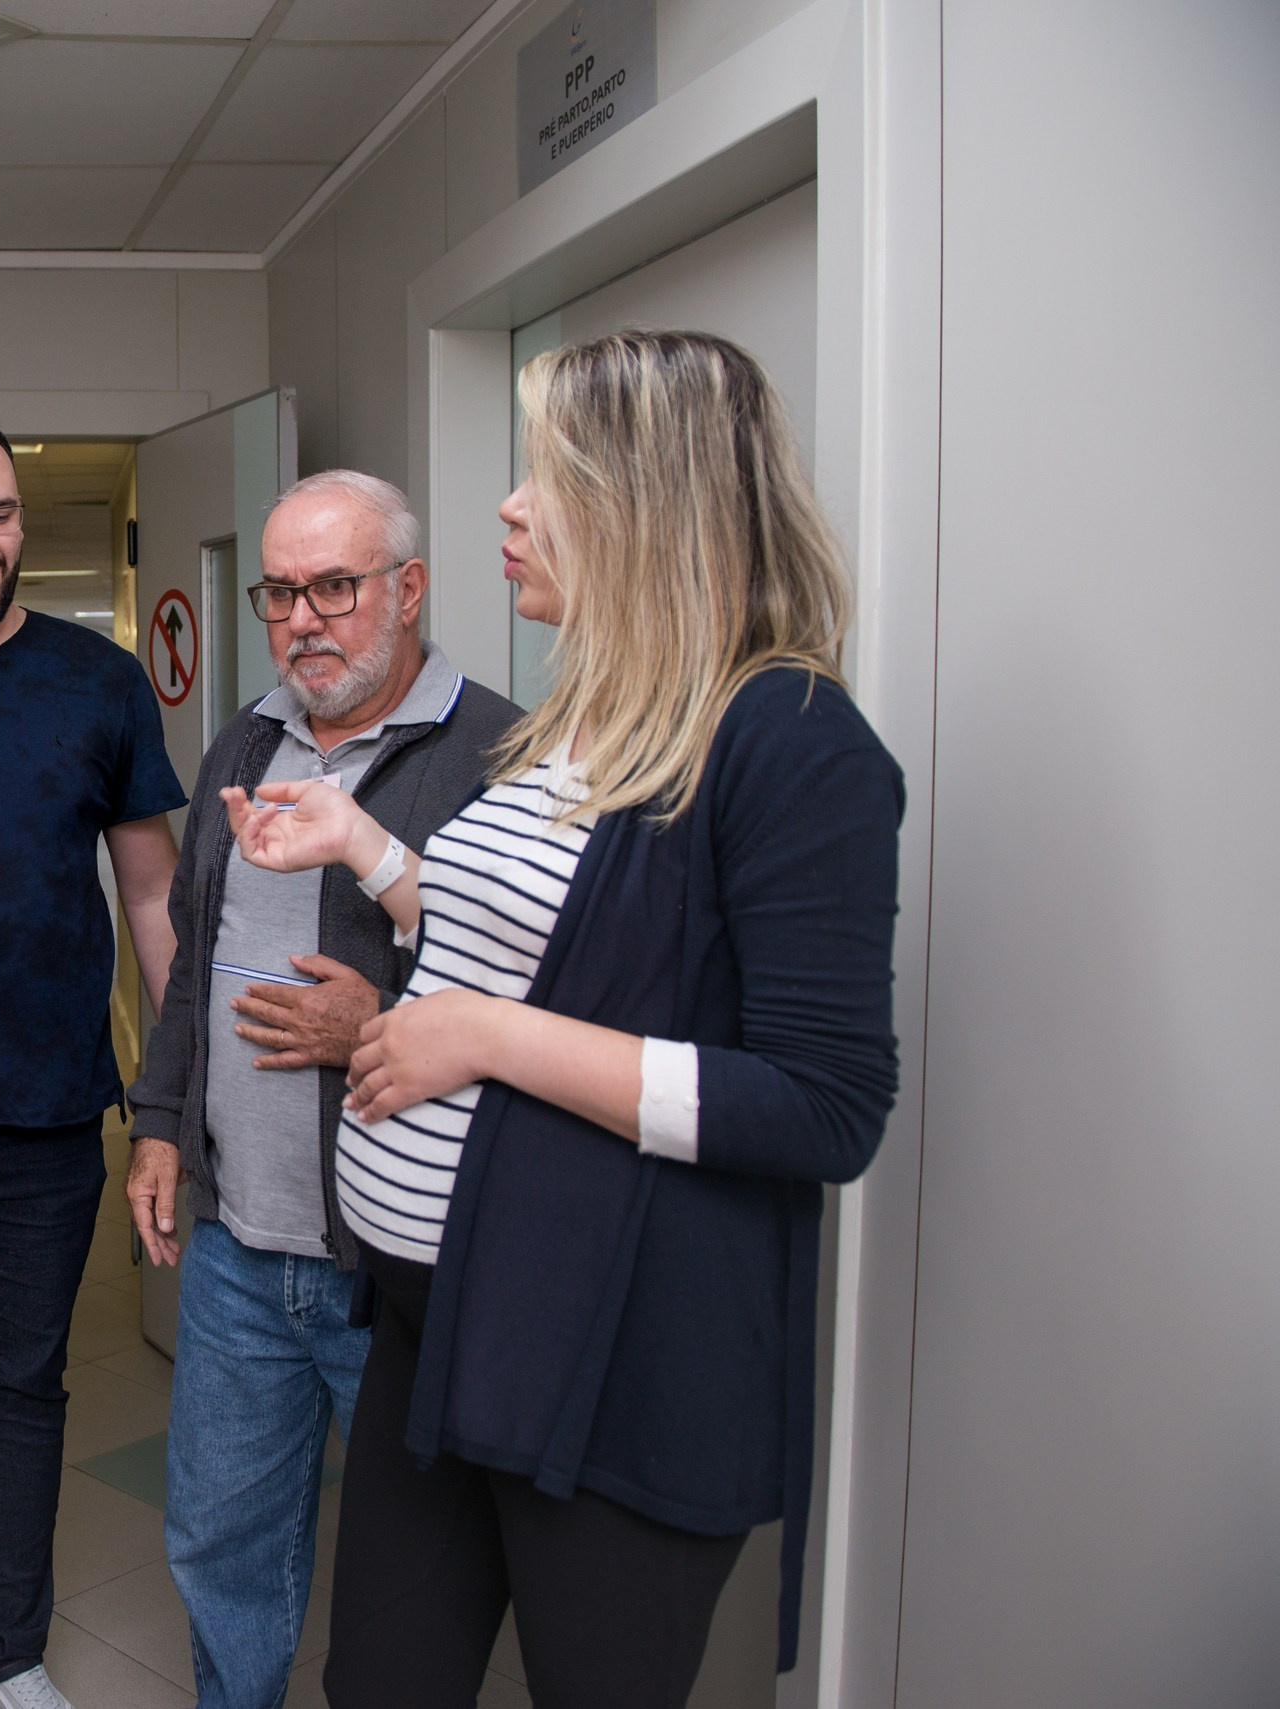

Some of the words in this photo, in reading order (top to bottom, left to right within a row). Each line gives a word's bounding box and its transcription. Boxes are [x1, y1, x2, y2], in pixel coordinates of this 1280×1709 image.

[565, 55, 595, 98] PPP
[539, 117, 556, 146] PRÉ
[551, 144, 557, 160] E
[559, 102, 614, 155] PUERPÉRIO
